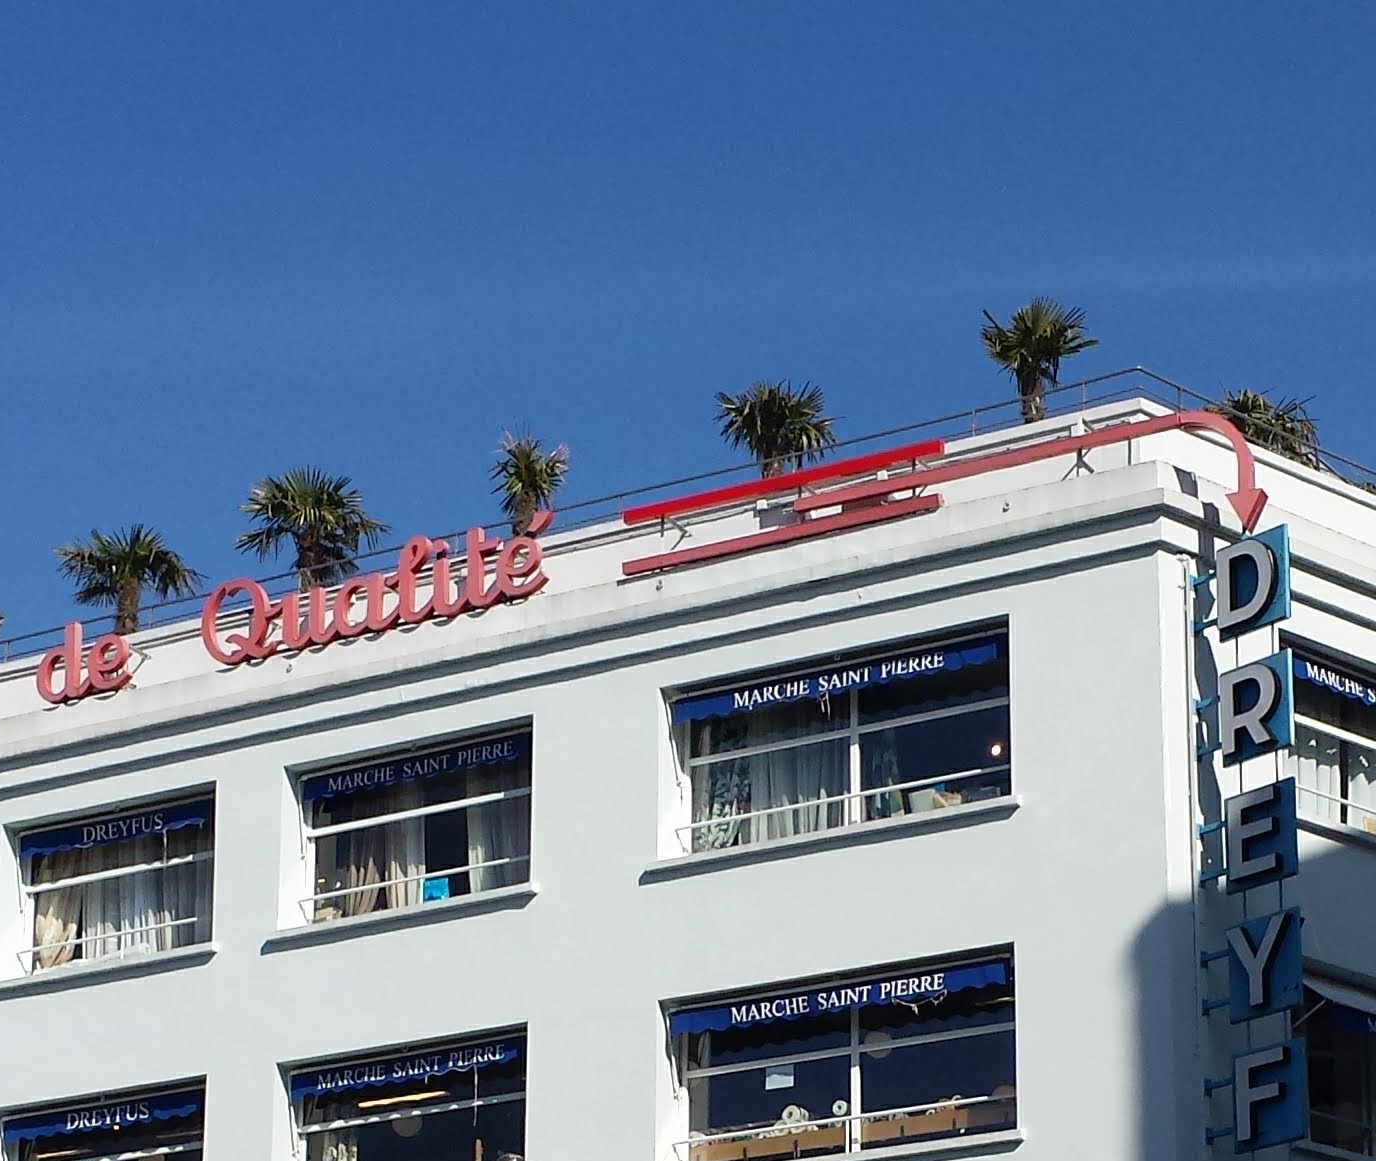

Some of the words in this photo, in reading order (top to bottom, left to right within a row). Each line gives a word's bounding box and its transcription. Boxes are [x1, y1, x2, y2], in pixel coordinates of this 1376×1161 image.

[37, 621, 134, 703] de
[202, 510, 554, 665] Qualité
[733, 679, 810, 709] MARCHE
[818, 666, 872, 694] SAINT
[881, 651, 945, 678] PIERRE
[1306, 662, 1363, 697] MARCHE
[327, 766, 395, 791] MARCHE
[402, 754, 450, 776] SAINT
[456, 740, 515, 767] PIERRE
[81, 812, 165, 842] DREYFUS
[730, 995, 810, 1024] MARCHE
[818, 986, 872, 1009] SAINT
[880, 972, 945, 1000] PIERRE
[316, 1064, 387, 1090] MARCHE
[393, 1055, 442, 1077] SAINT
[448, 1044, 505, 1068] PIERRE
[66, 1102, 149, 1129] DREYFUS
